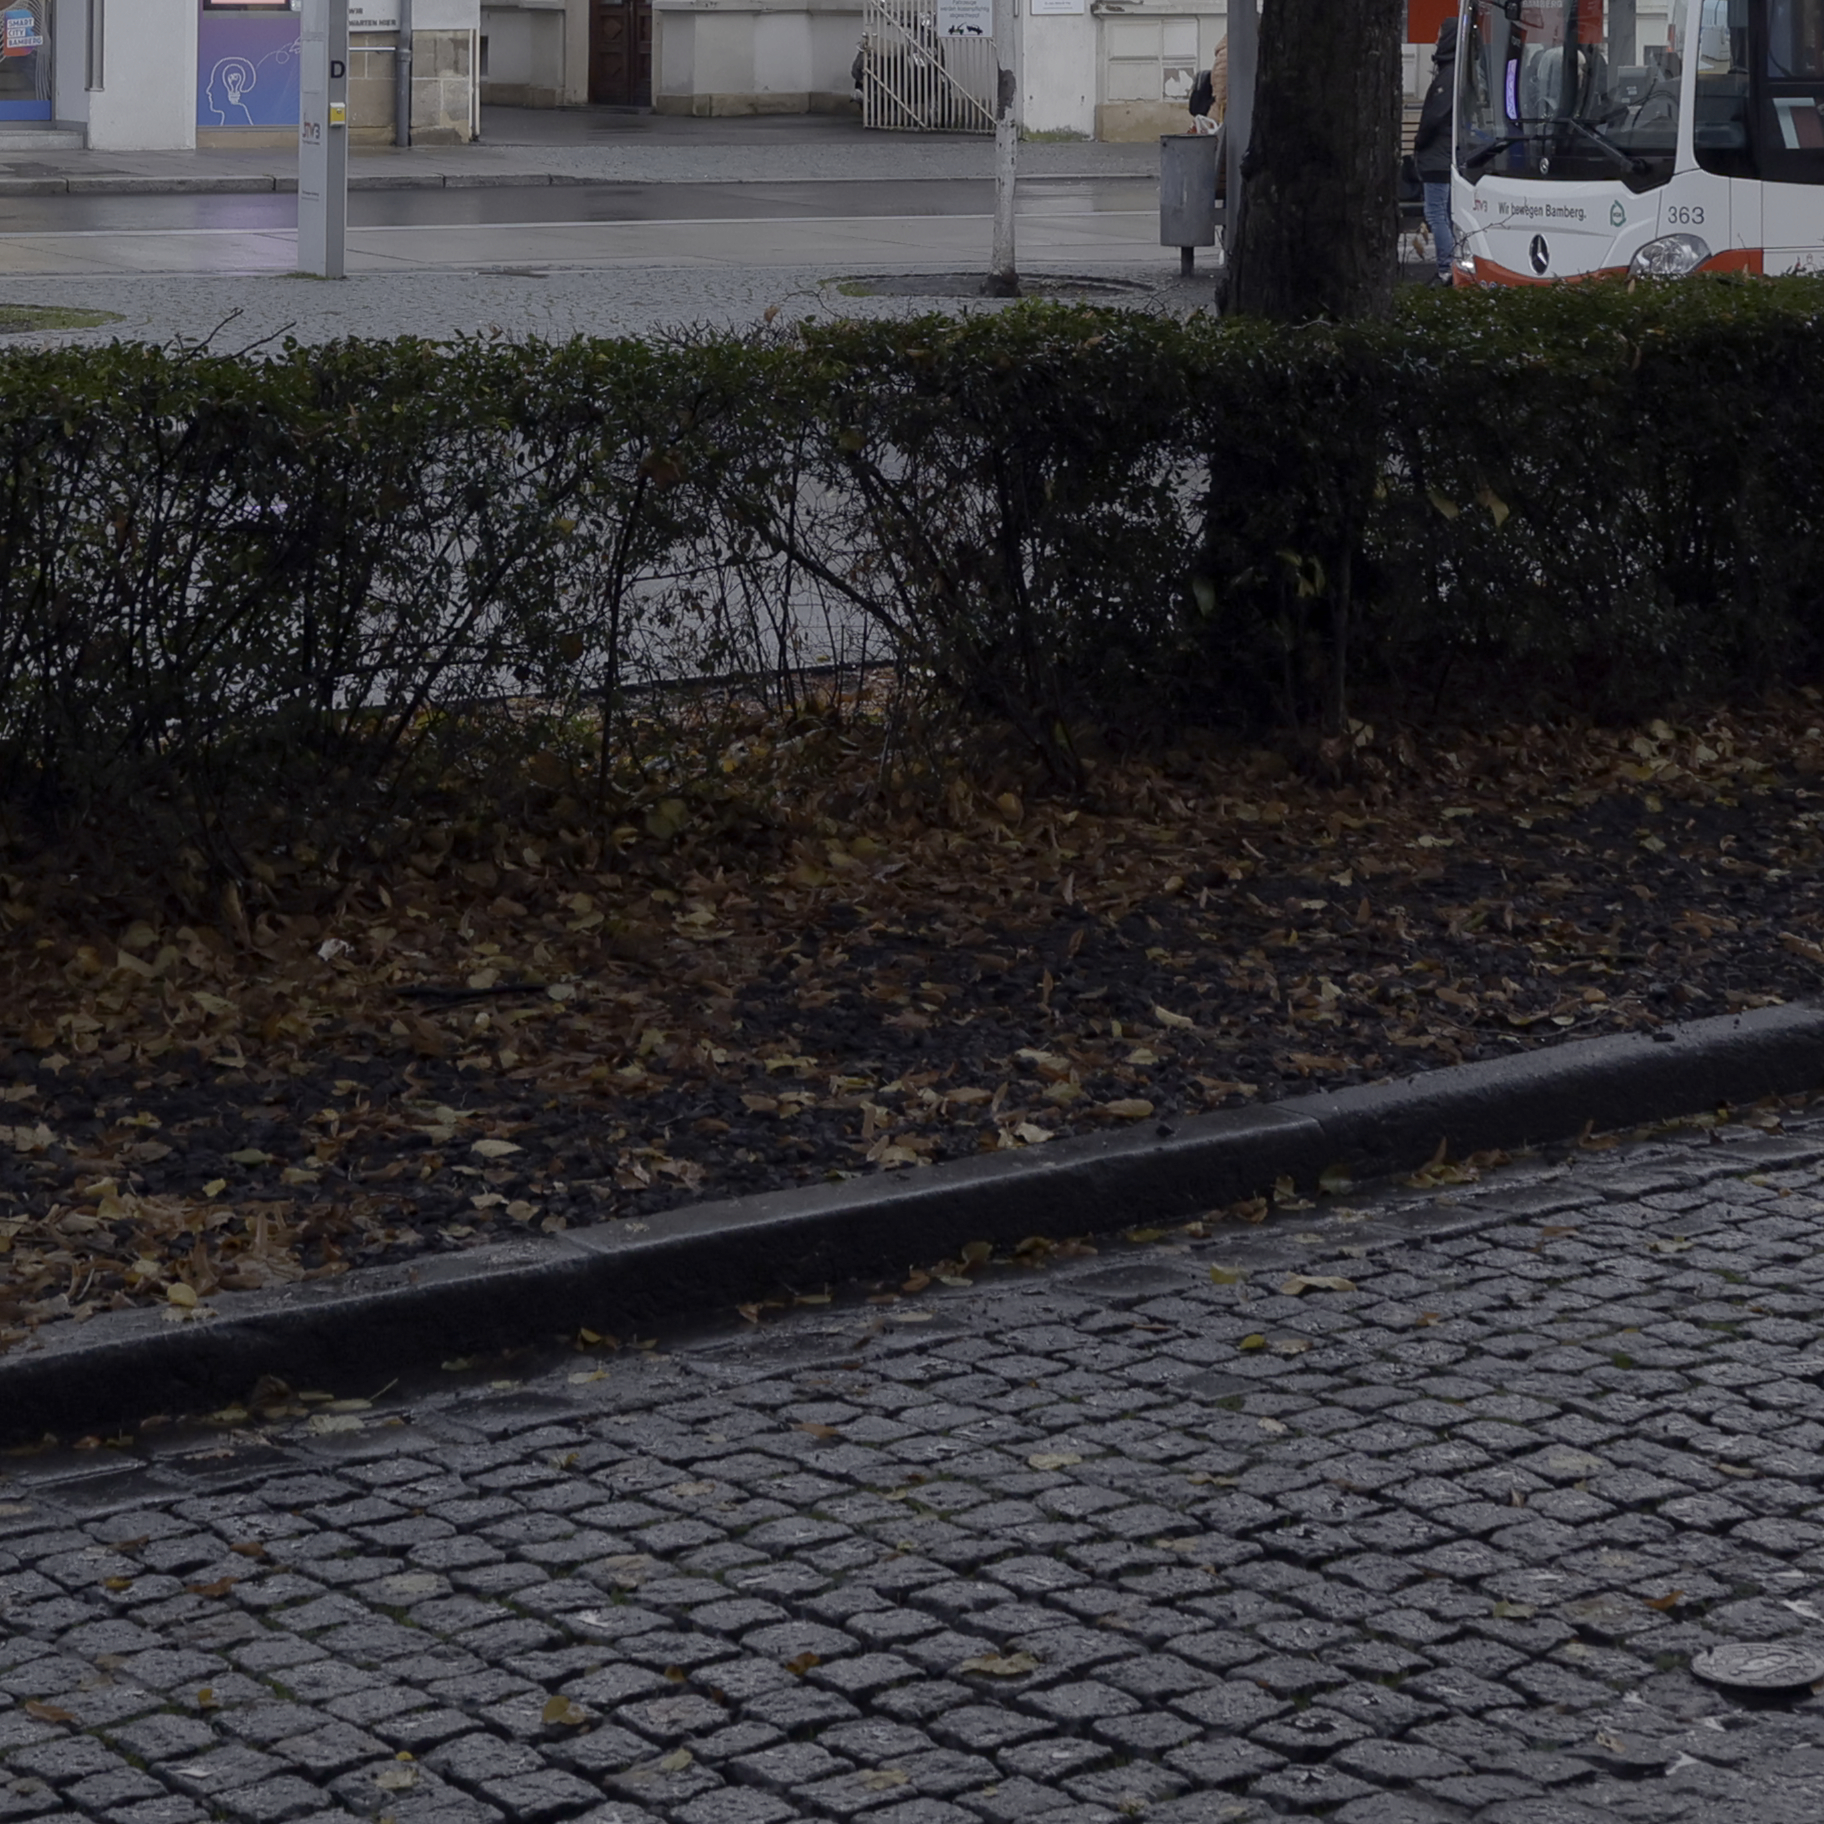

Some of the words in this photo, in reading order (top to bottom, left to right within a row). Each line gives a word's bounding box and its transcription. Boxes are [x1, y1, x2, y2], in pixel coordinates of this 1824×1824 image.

[1522, 0, 1563, 8] BAMBERG
[8, 18, 33, 26] SMART
[8, 28, 24, 37] CITY
[330, 60, 346, 78] D
[1498, 202, 1509, 215] Wir
[1510, 202, 1544, 219] bewegen
[1545, 204, 1587, 220] Bamberg.
[1667, 206, 1705, 225] 363
